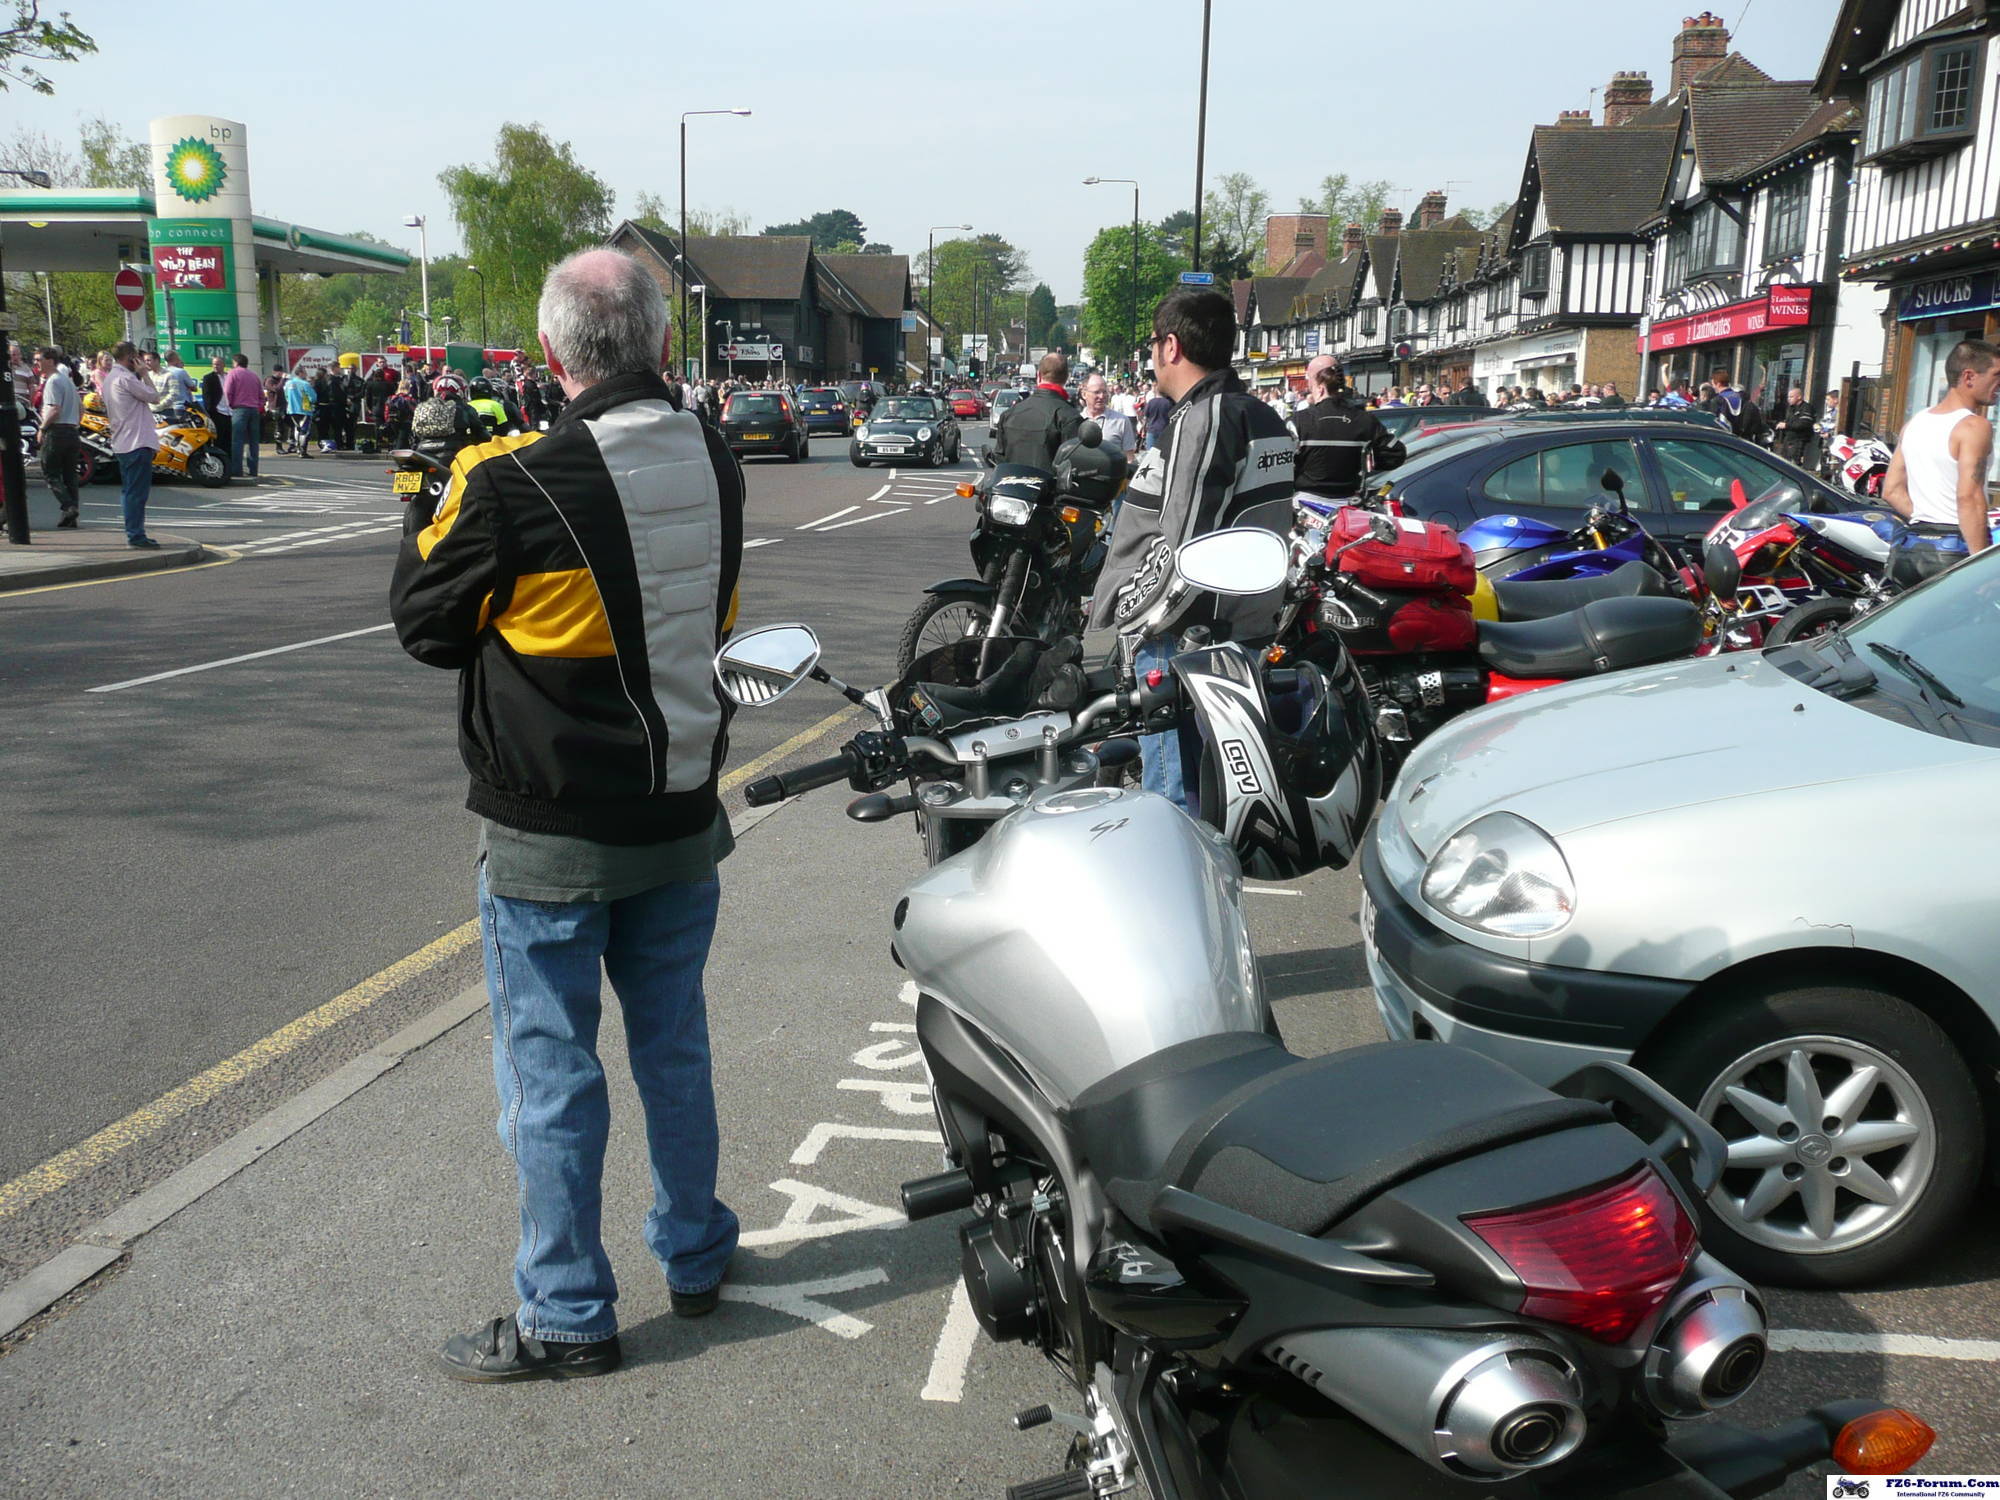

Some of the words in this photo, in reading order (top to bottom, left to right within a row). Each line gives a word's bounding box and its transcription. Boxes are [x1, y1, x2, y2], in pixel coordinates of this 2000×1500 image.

[210, 124, 232, 143] bp
[168, 228, 224, 238] connect
[176, 247, 194, 256] THE
[187, 257, 216, 271] BEAN
[1915, 276, 1971, 308] STOCKS
[1771, 305, 1808, 315] WINES
[1748, 314, 1765, 330] WINES
